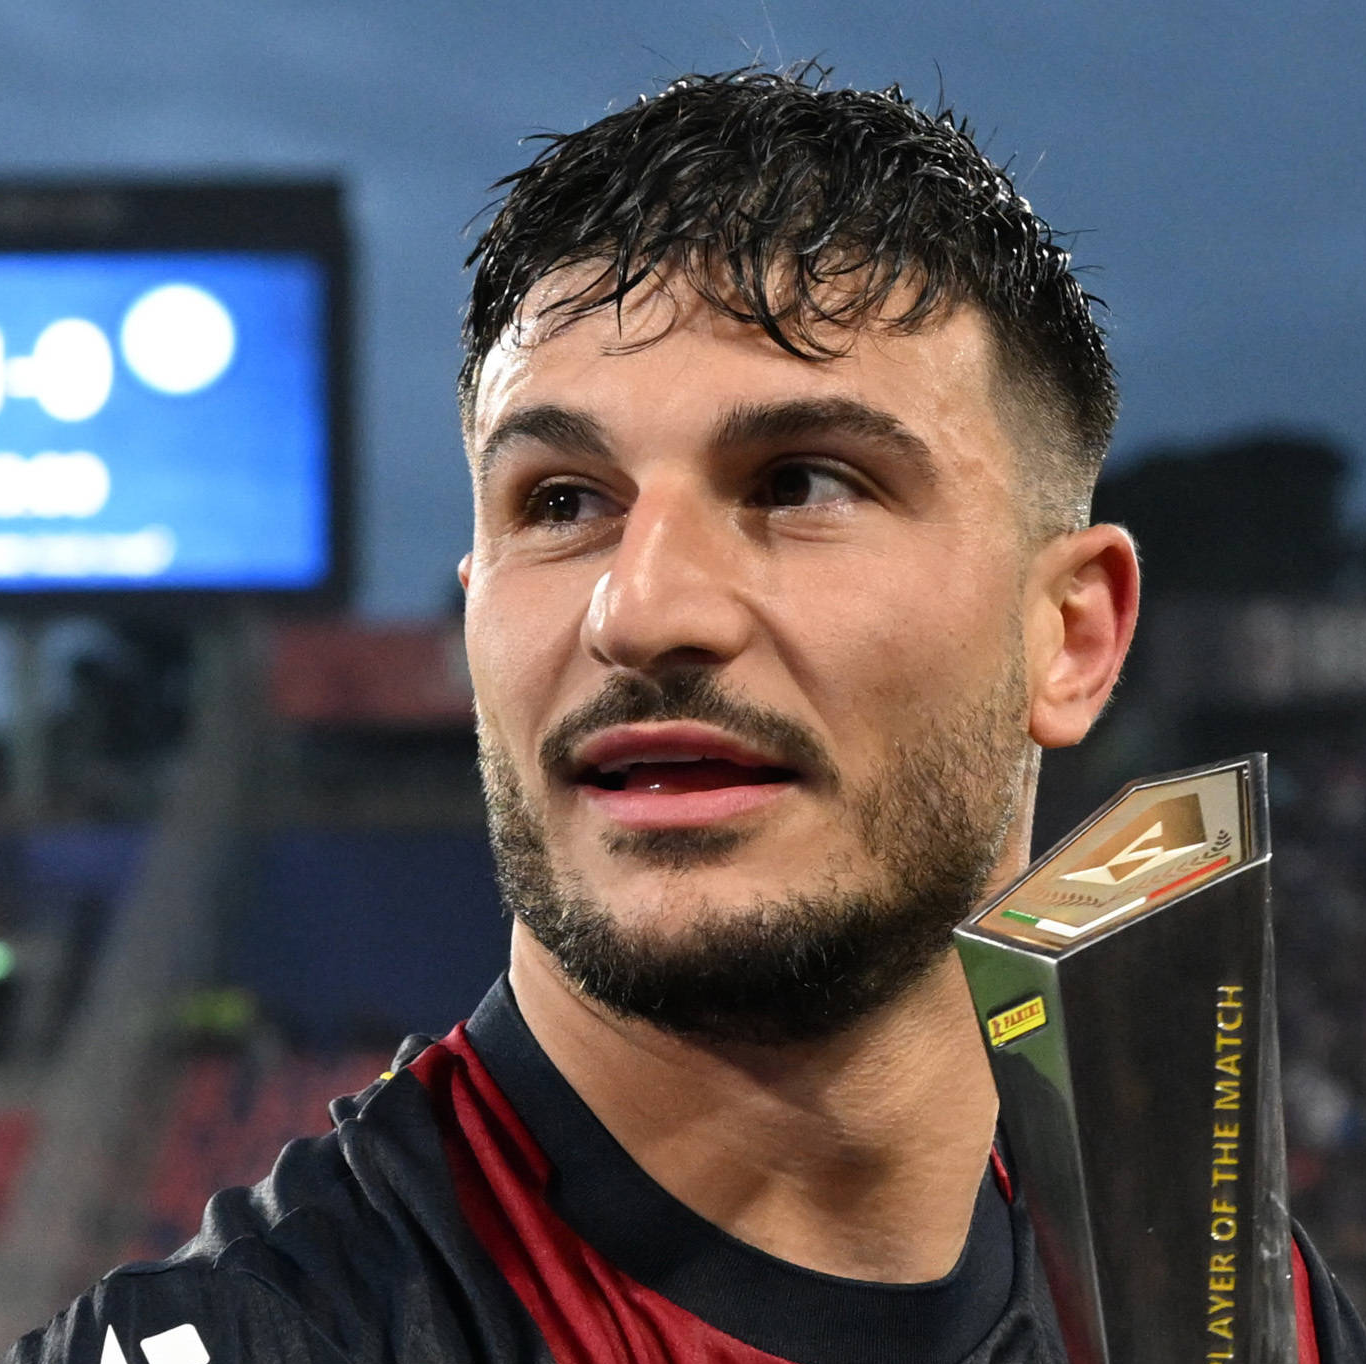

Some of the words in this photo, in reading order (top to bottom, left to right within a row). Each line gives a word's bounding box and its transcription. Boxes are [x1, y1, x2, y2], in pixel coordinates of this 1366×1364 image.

[1214, 985, 1244, 1110] MATCH
[1211, 1122, 1239, 1187] THE
[1210, 1200, 1237, 1242] OF
